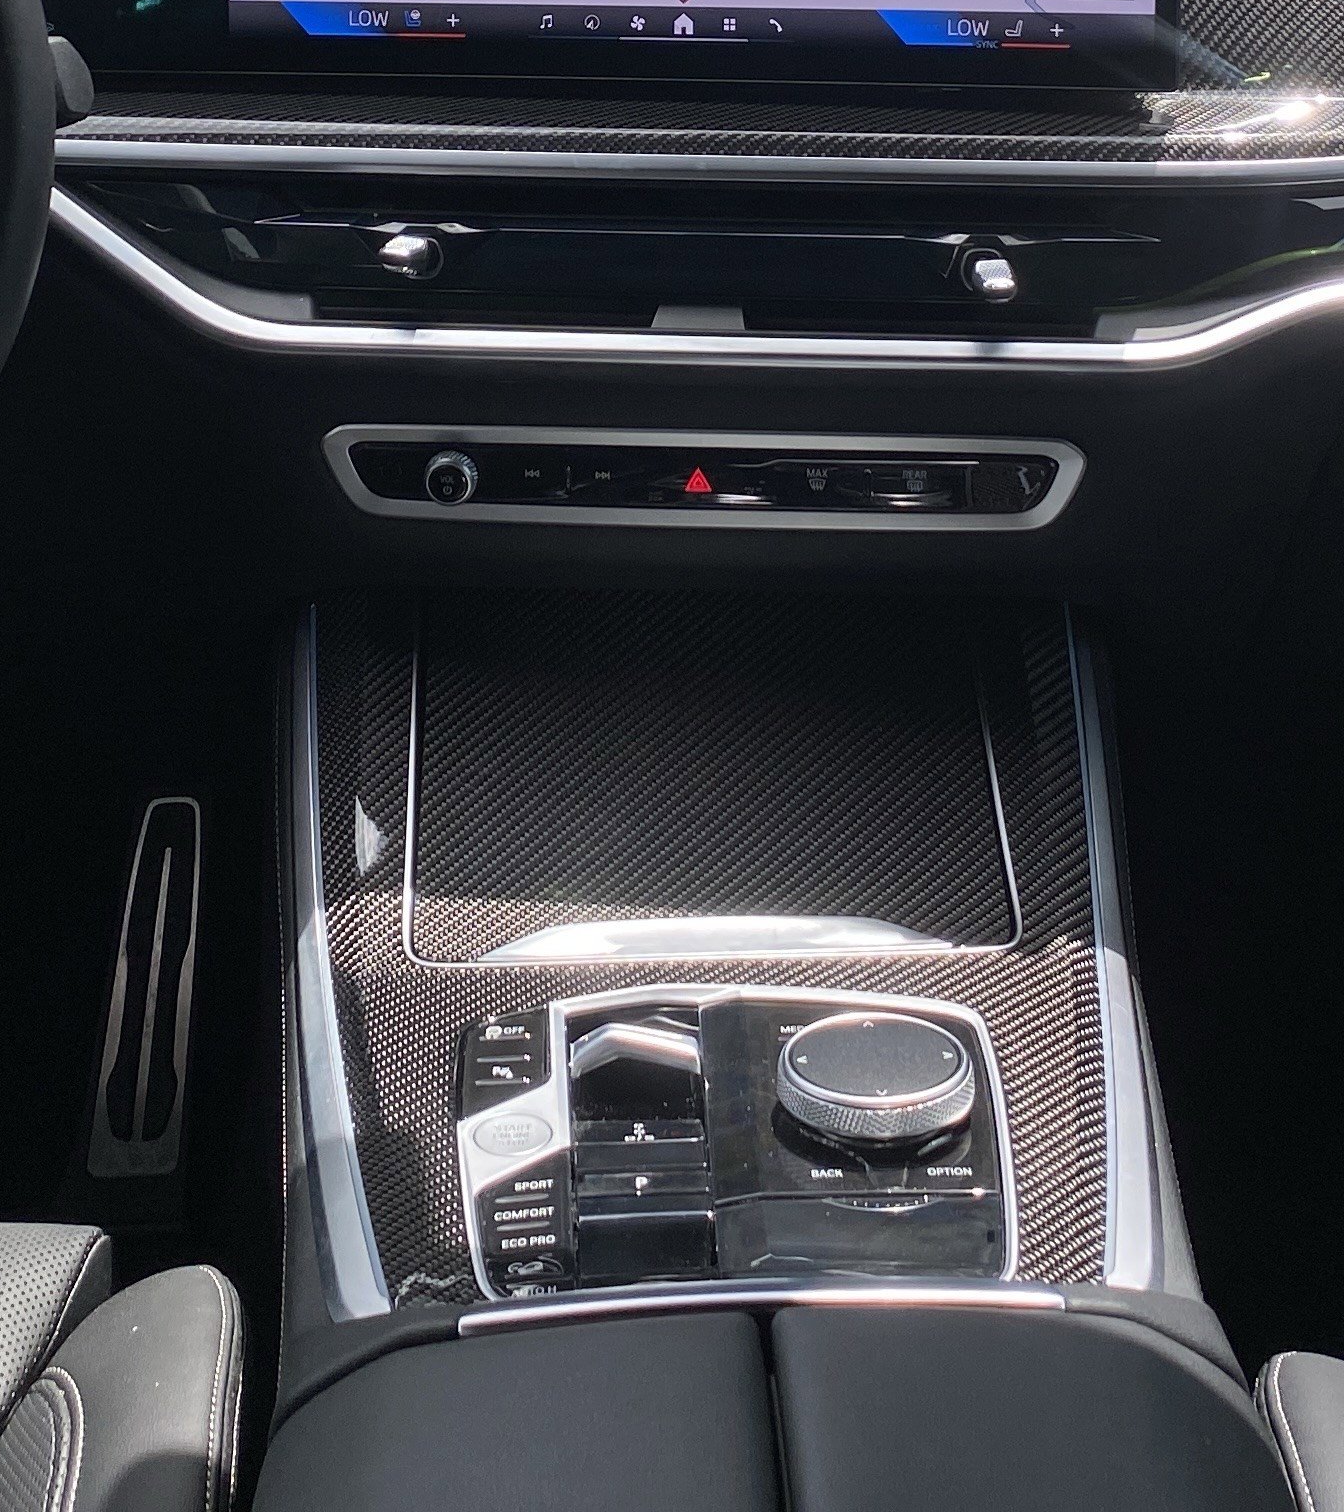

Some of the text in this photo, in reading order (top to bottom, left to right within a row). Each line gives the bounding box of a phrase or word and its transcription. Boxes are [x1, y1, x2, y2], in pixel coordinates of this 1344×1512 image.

[349, 10, 389, 28] LOW
[948, 18, 989, 37] LOW
[976, 40, 999, 49] SYNC
[806, 468, 828, 478] MAX
[902, 470, 928, 480] REAR
[503, 1025, 526, 1036] OFF
[810, 1168, 844, 1179] BACK
[926, 1166, 973, 1178] OPTION
[514, 1178, 554, 1192] SPORT
[635, 1176, 648, 1190] P
[494, 1206, 555, 1222] COMFORT
[501, 1234, 556, 1250] ECO PRO
